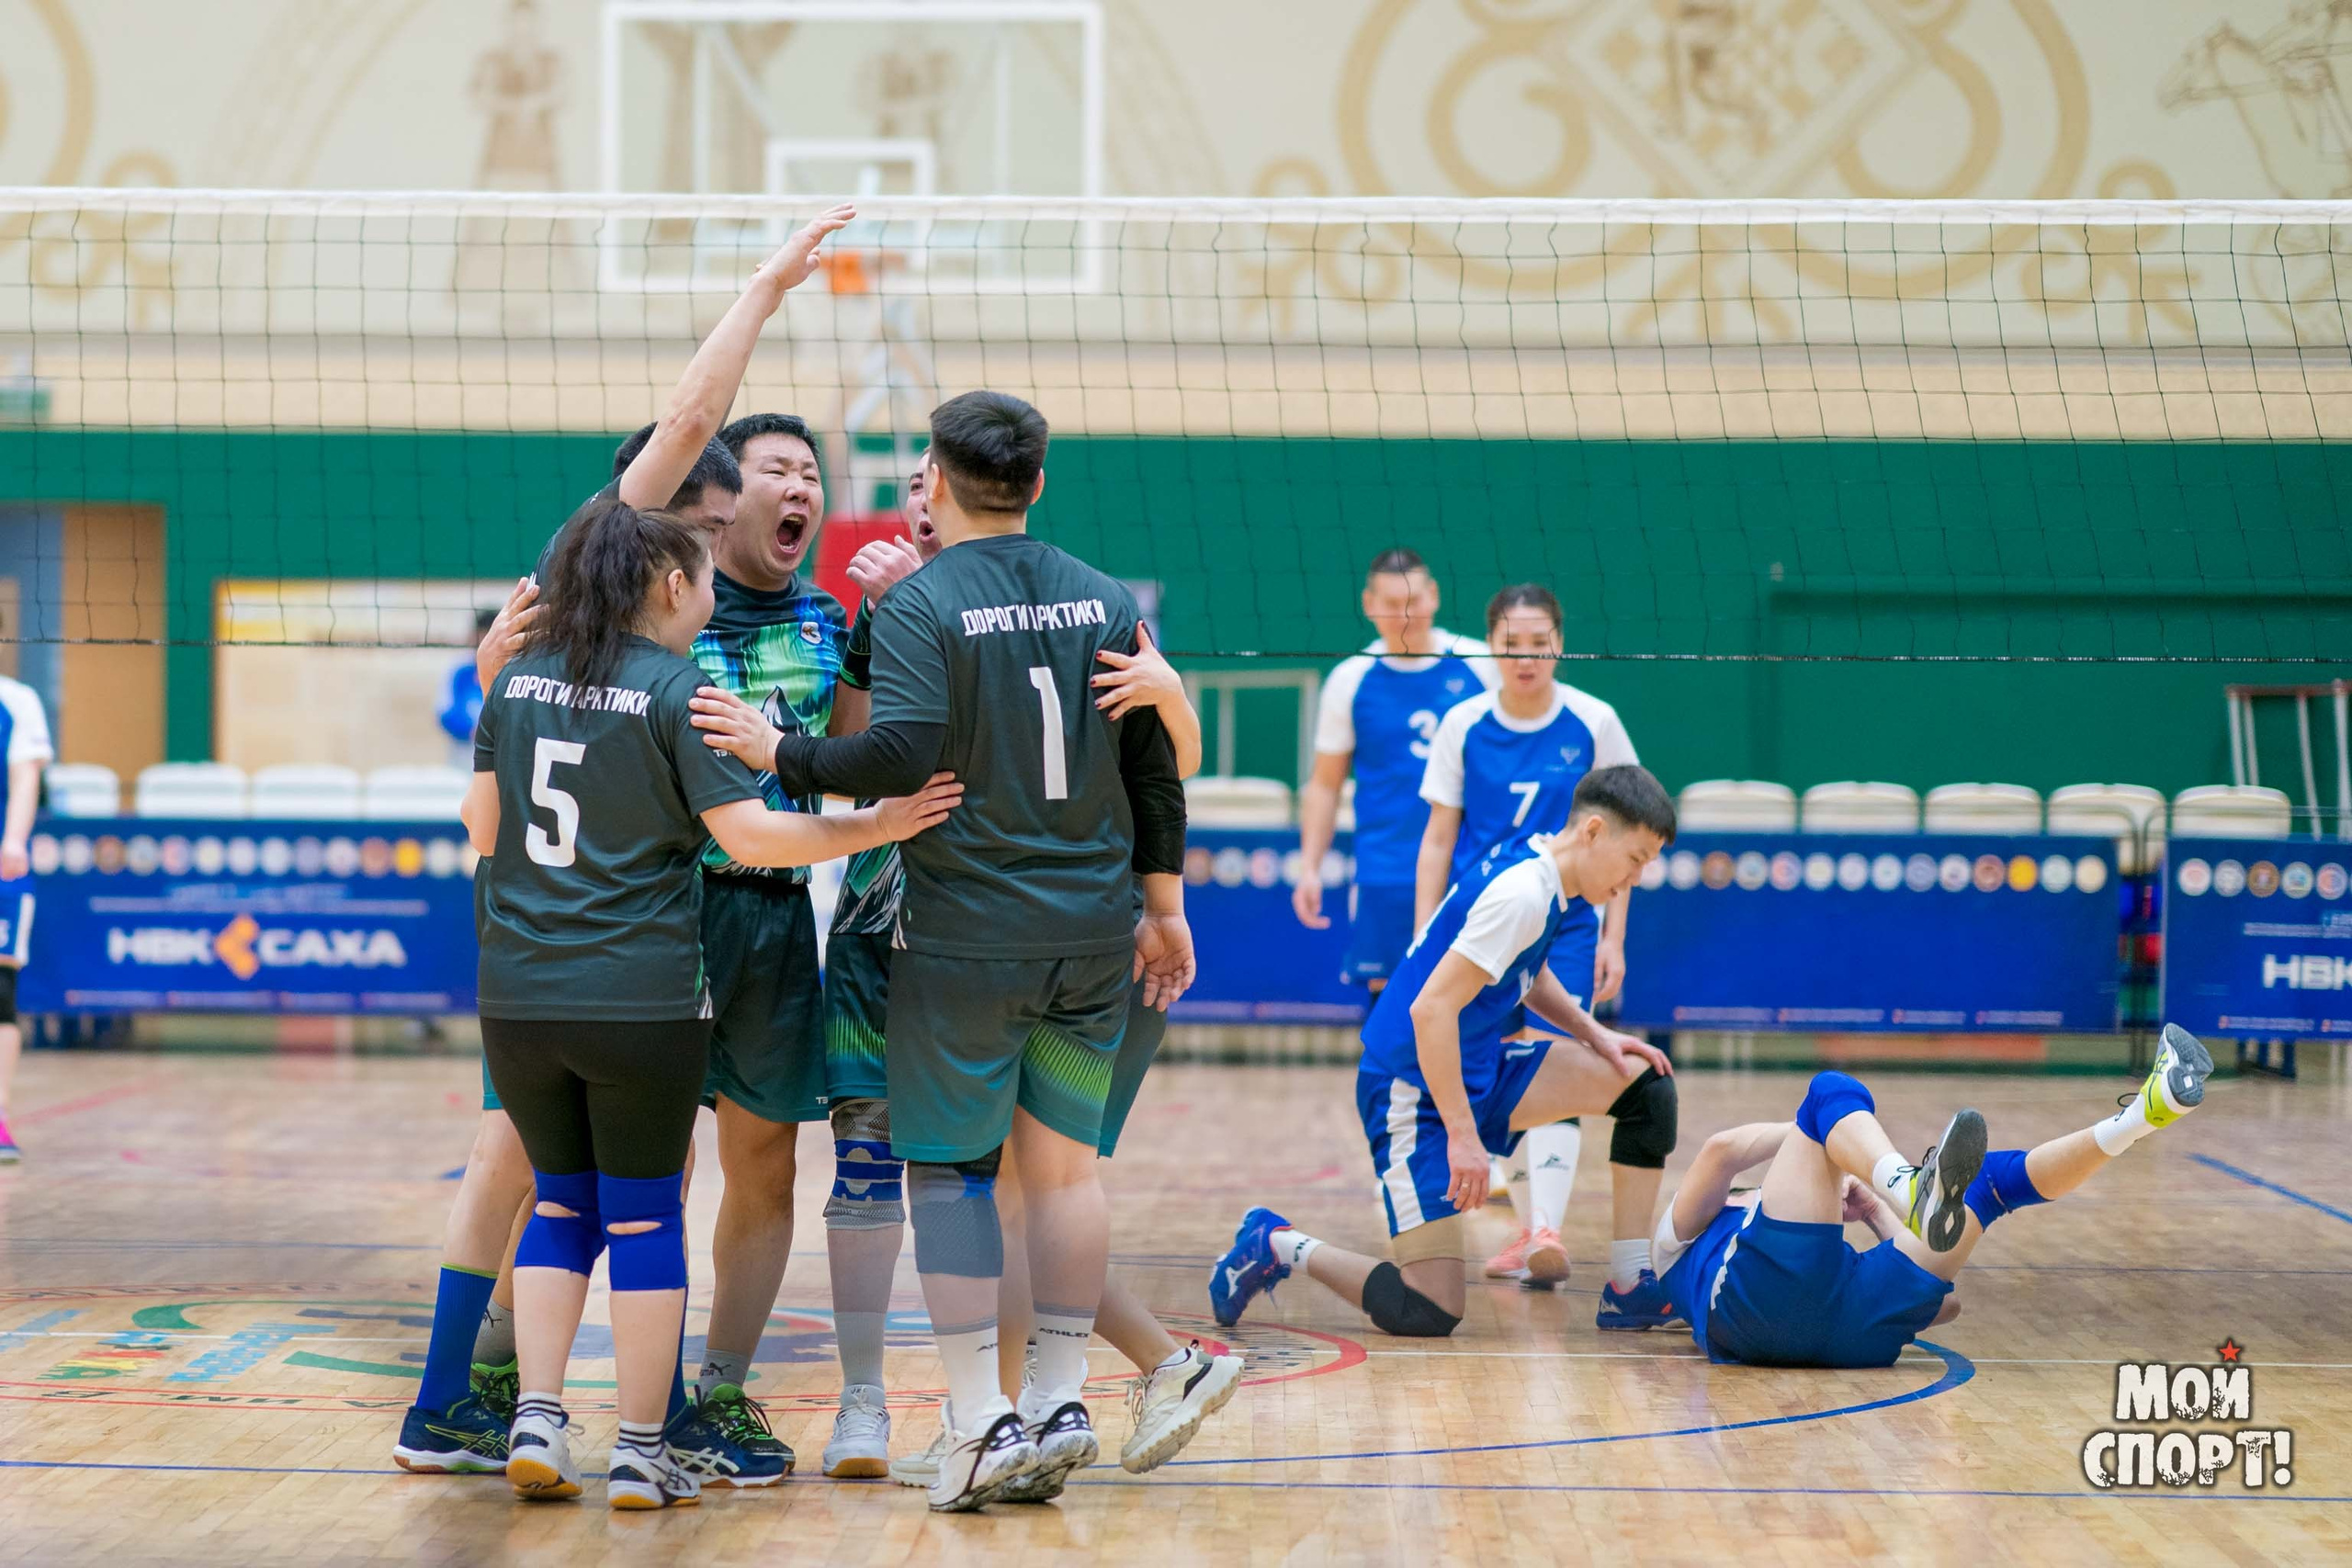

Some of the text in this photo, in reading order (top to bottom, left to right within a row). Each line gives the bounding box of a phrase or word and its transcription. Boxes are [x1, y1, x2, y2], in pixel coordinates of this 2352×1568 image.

[961, 604, 1029, 636] ДОРОГИ
[504, 675, 573, 706] ДОРОГИ
[1028, 666, 1068, 799] 1
[1408, 709, 1440, 760] 3
[525, 737, 586, 868] 5
[1509, 781, 1540, 828] 7
[258, 928, 408, 968] САХА
